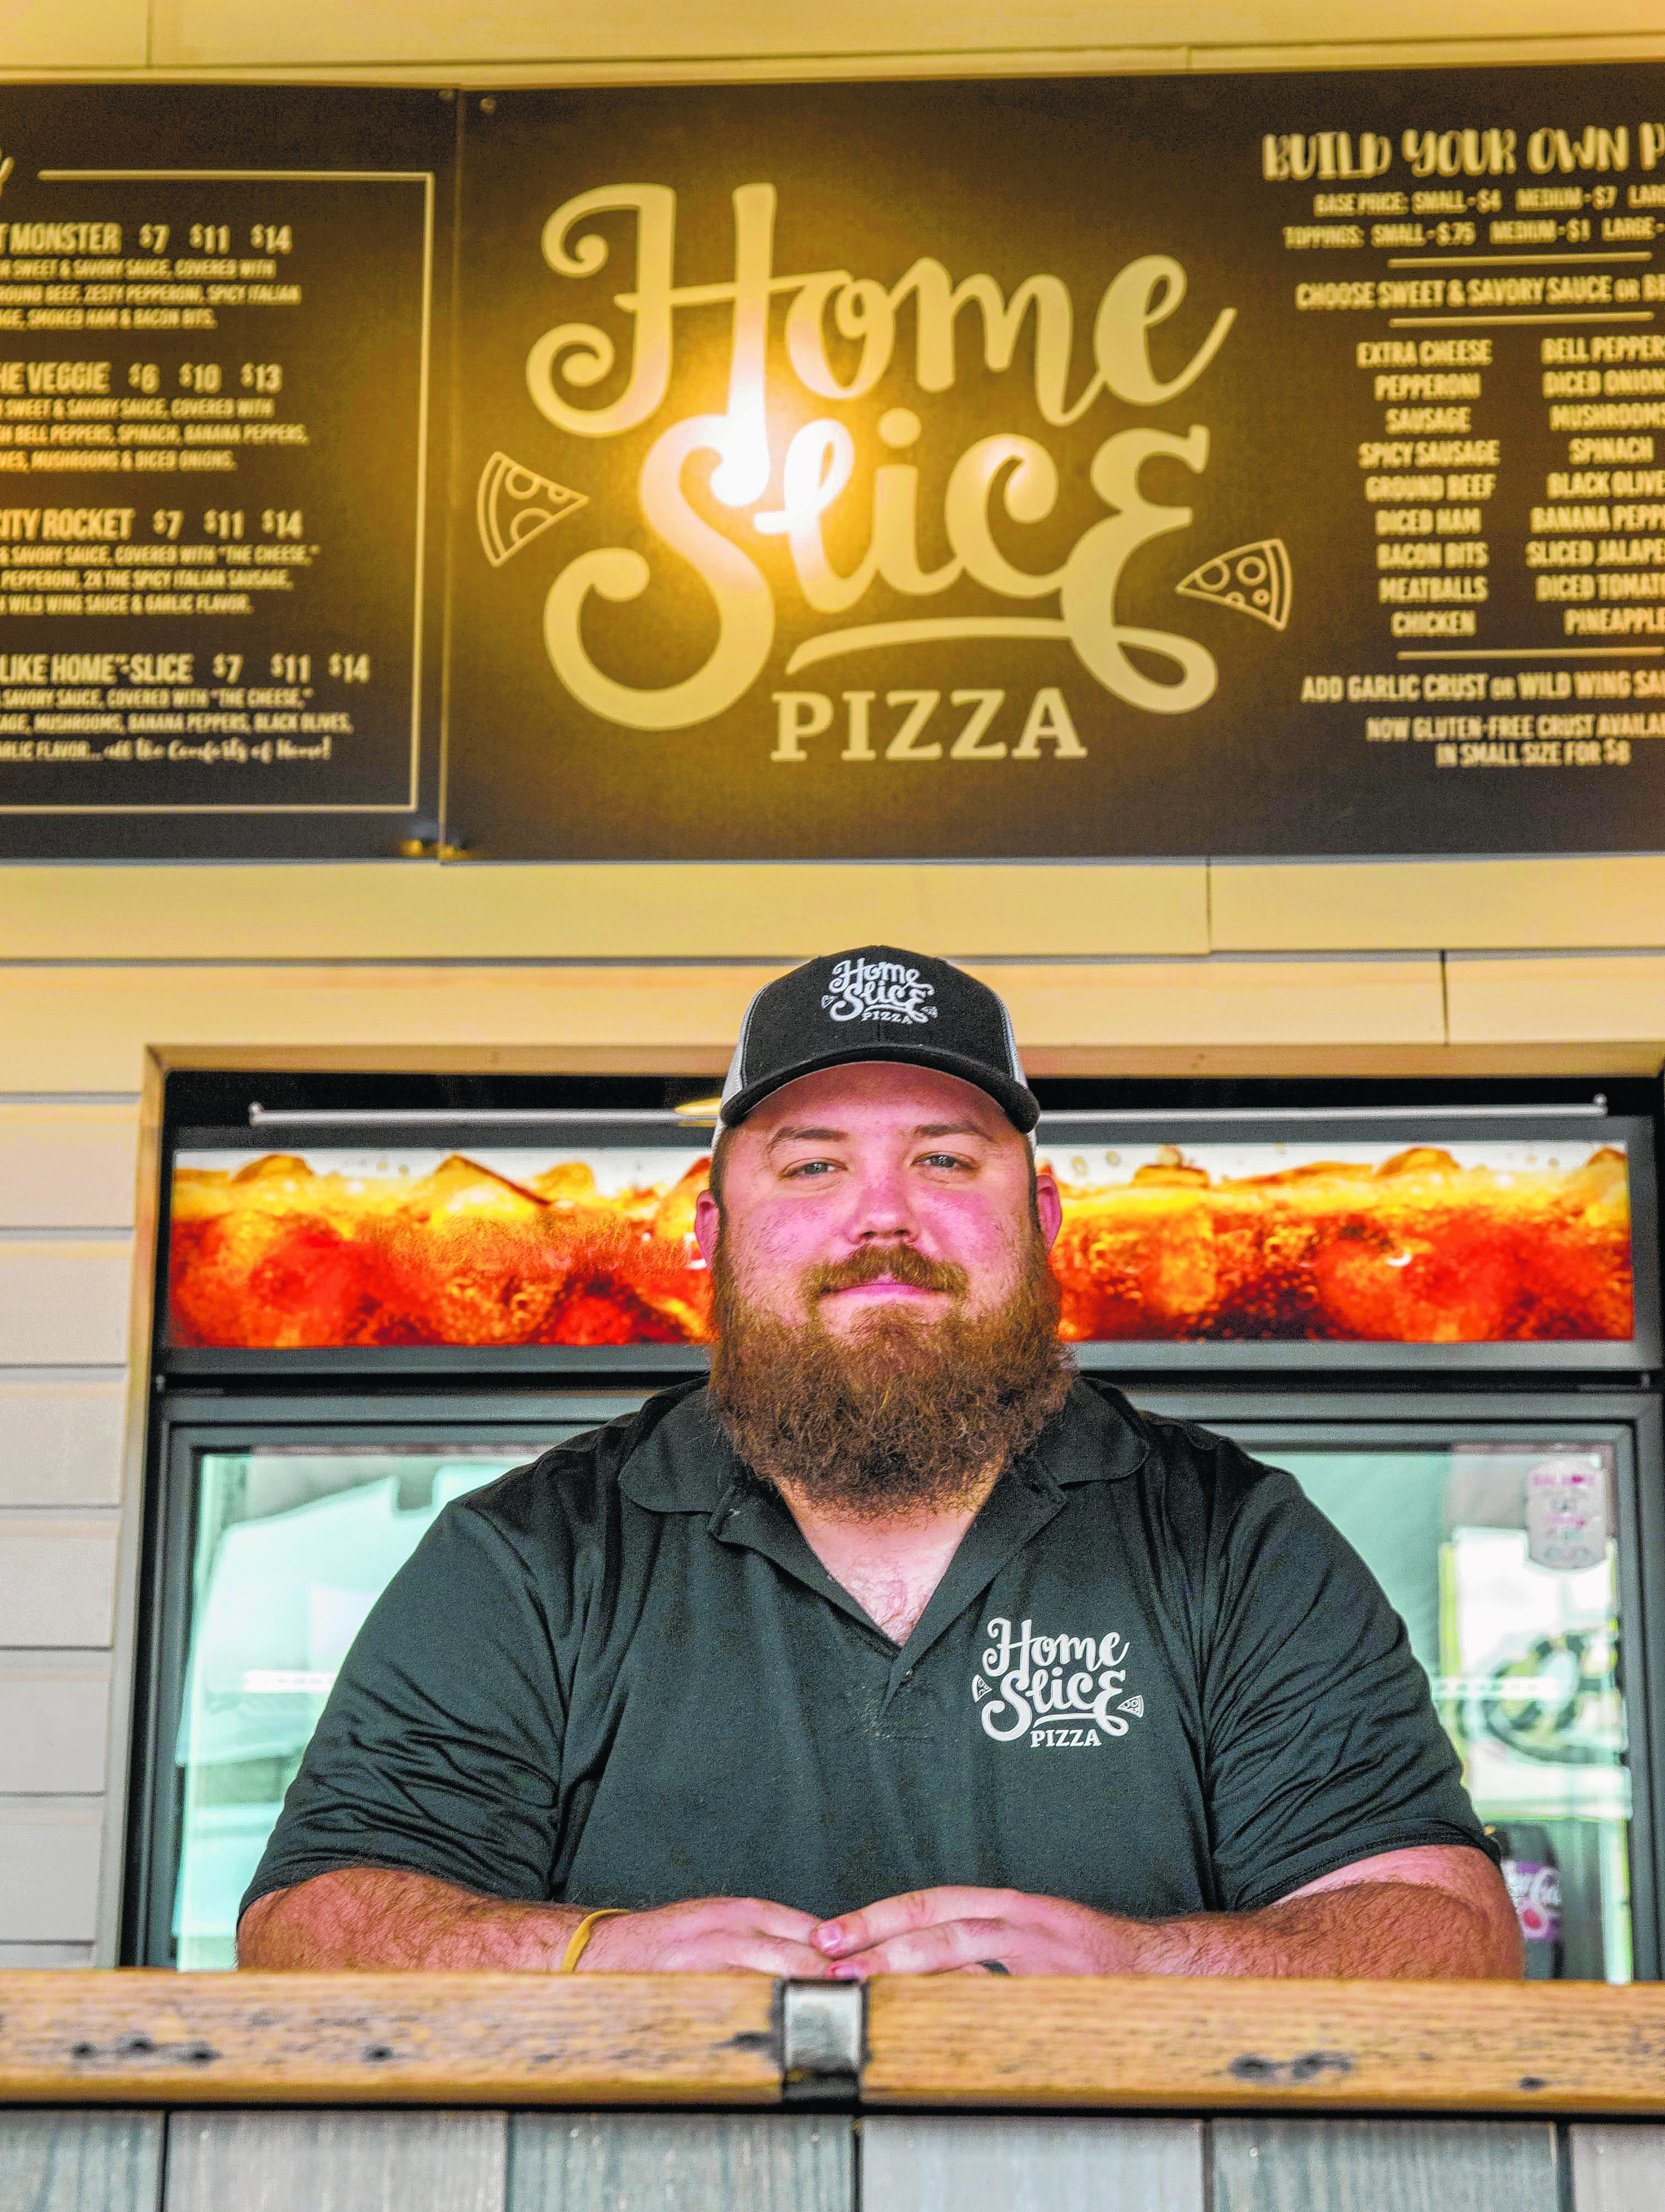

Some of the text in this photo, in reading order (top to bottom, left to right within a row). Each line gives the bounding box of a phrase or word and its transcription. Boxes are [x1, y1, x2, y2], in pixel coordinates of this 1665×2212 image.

[1264, 131, 1392, 180] BUILD
[1401, 128, 1517, 177] YOUR
[1527, 125, 1629, 174] OWN
[1314, 193, 1357, 216] BASE
[9, 222, 123, 254] MONSTER
[139, 222, 170, 254] $7
[189, 222, 230, 254] $11
[250, 222, 292, 254] $14
[13, 259, 58, 281] SWEET
[59, 259, 72, 281] &
[72, 259, 125, 281] SAVORY
[173, 259, 238, 280] COVERED
[238, 259, 276, 280] WITH
[84, 285, 126, 306] ZESTY
[206, 285, 247, 306] SPICY
[247, 285, 302, 306] ITALIAN
[1294, 281, 1376, 310] CHOOSE
[1376, 279, 1445, 309] SWEET
[1446, 278, 1467, 307] &
[1467, 276, 1544, 307] SAVORY
[1544, 275, 1613, 304] SAUCE
[27, 308, 84, 329] SMOKED
[119, 308, 132, 329] &
[133, 308, 181, 329] BACON
[526, 183, 1237, 498] Home
[1356, 338, 1493, 368] EXTRA CHEESE
[1541, 336, 1590, 364] BELL
[27, 362, 112, 394] VEGGIE
[127, 362, 160, 394] $6
[178, 362, 222, 394] $10
[240, 362, 284, 394] $13
[1374, 373, 1482, 401] PEPPERONI
[1542, 370, 1602, 398] DICED
[5, 398, 53, 419] SWEET
[53, 398, 66, 419] &
[66, 398, 120, 419] SAVORY
[171, 398, 235, 419] COVERED
[236, 398, 275, 419] WITH
[1385, 406, 1472, 434] SAUSAGE
[15, 424, 50, 446] BELL
[183, 424, 242, 446] BANANA
[31, 450, 120, 472] MUSHROOMS
[120, 450, 134, 472] &
[134, 450, 178, 472] DICED
[1358, 439, 1501, 468] SPICY SAUSAGE
[1569, 436, 1655, 465] SPINACH
[1365, 473, 1497, 502] GROUND BEEF
[1546, 471, 1609, 500] BLACK
[41, 508, 136, 541] ROCKET
[153, 508, 184, 540] $7
[203, 508, 245, 540] $11
[261, 508, 302, 540] $14
[1375, 508, 1482, 536] DICED HAM
[1530, 506, 1610, 534] BANANA
[11, 545, 63, 566] SAVORY
[114, 544, 177, 566] COVERED
[179, 544, 217, 566] WITH
[1376, 541, 1488, 570] BACON BITS
[1525, 540, 1596, 568] SLICED
[104, 570, 133, 591] THE
[133, 569, 172, 591] SPICY
[172, 569, 227, 590] ITALIAN
[1378, 576, 1488, 604] MEATBALLS
[1535, 574, 1596, 602] DICED
[8, 595, 45, 615] WILD
[45, 595, 84, 615] WING
[84, 595, 131, 615] SAUCE
[131, 595, 144, 615] &
[144, 595, 194, 615] GARLIC
[1391, 609, 1477, 638] CHICKEN
[0, 653, 49, 685] LIKE
[212, 653, 244, 684] $7
[270, 653, 312, 684] $11
[329, 653, 371, 684] $14
[2, 689, 55, 710] SAVORY
[106, 689, 172, 710] COVERED
[172, 688, 210, 709] WITH
[1301, 675, 1345, 703] ADD
[1346, 674, 1421, 702] GARLIC
[1422, 673, 1488, 701] CRUST
[1517, 672, 1573, 699] WILD
[1573, 670, 1631, 699] WING
[127, 714, 186, 734] BANANA
[253, 713, 300, 734] BLACK
[771, 687, 1088, 762] PIZZA
[1365, 714, 1596, 742] NOW GLUTEN-FREE CRUST
[1435, 740, 1601, 769] IN SMALL SIZE FOR
[828, 957, 922, 994] Home
[860, 1011, 914, 1025] PIZZA
[982, 1617, 1130, 1688] Home
[1030, 1729, 1102, 1748] PIZZA
